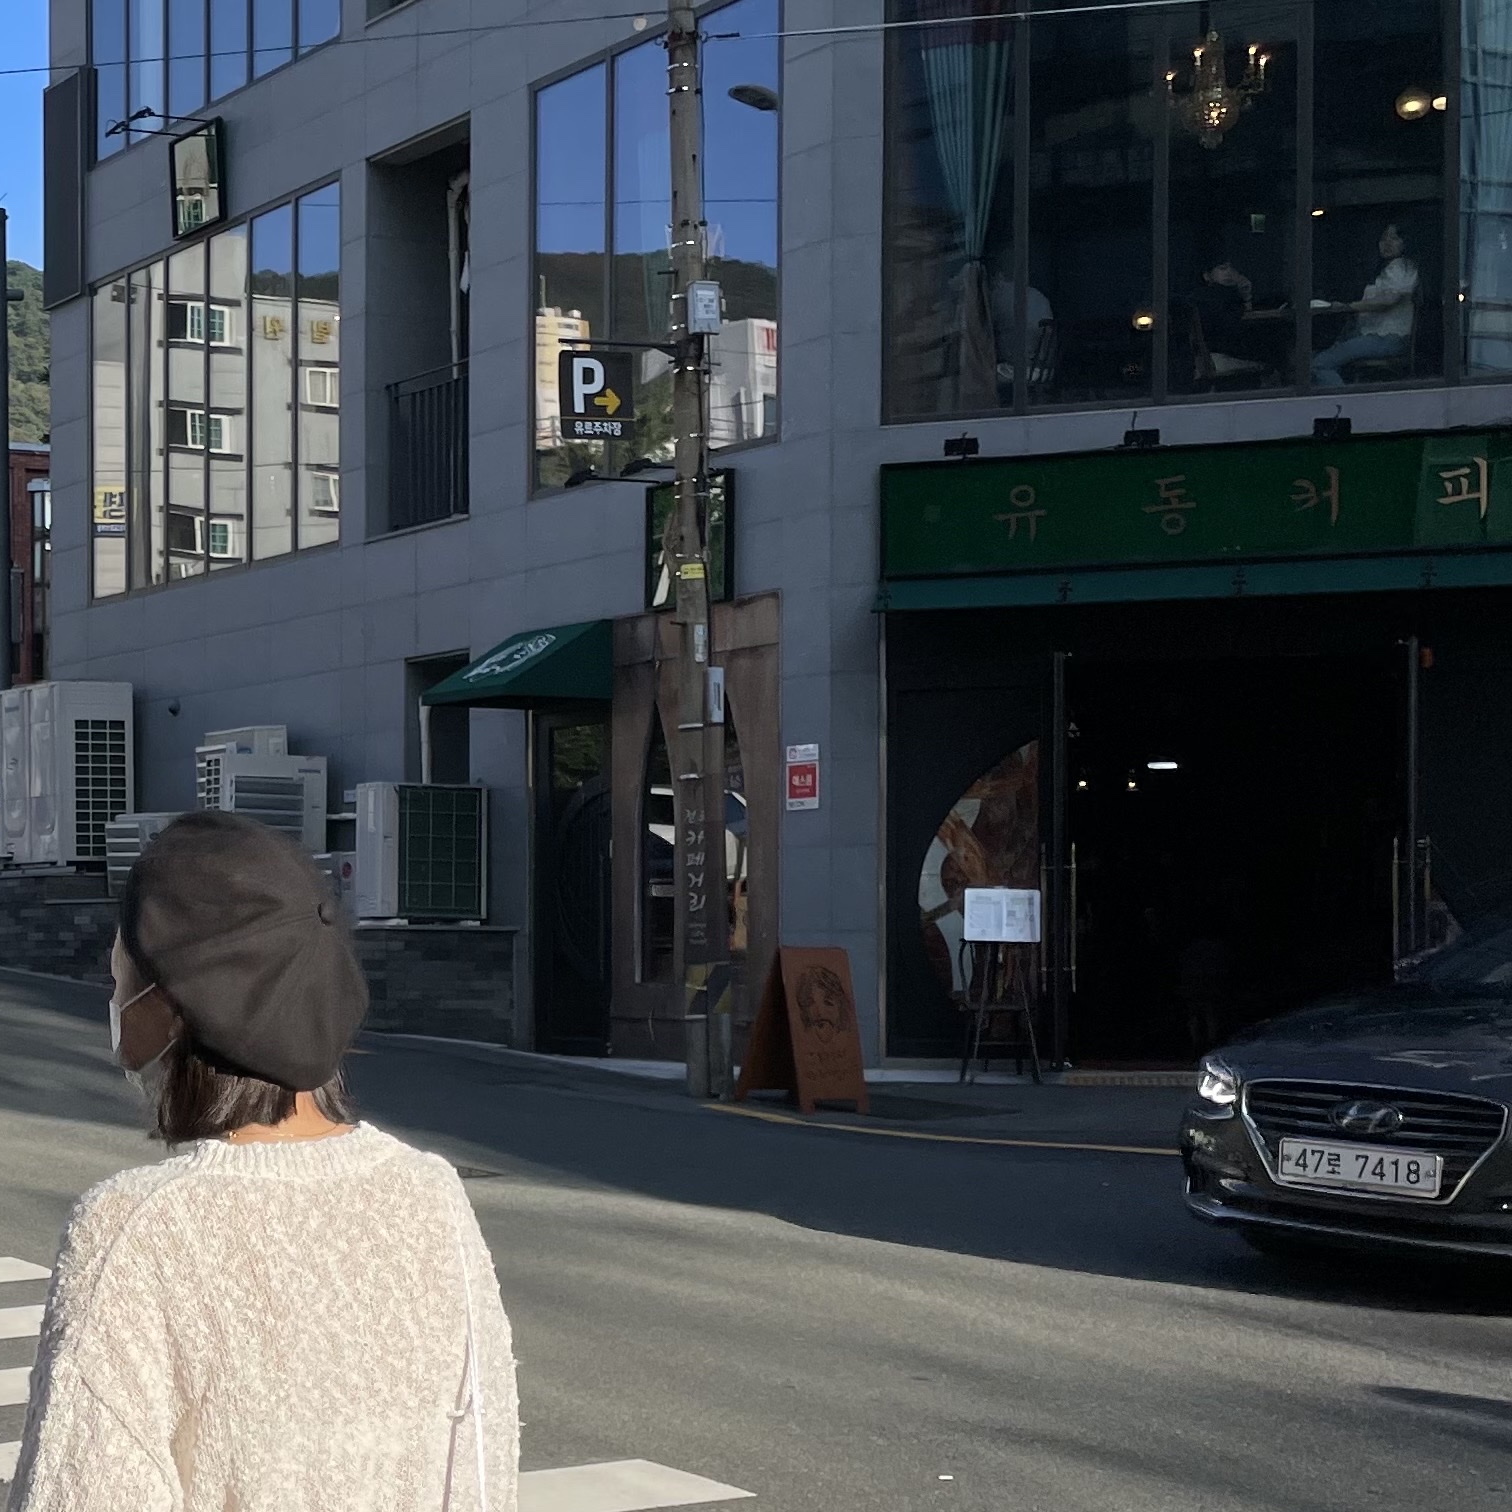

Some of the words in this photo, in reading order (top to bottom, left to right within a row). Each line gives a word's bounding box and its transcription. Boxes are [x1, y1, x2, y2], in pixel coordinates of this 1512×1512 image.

[572, 357, 605, 414] P
[573, 420, 622, 436] 유료주차장
[1294, 1147, 1341, 1176] 47로
[1354, 1153, 1422, 1186] 7418
